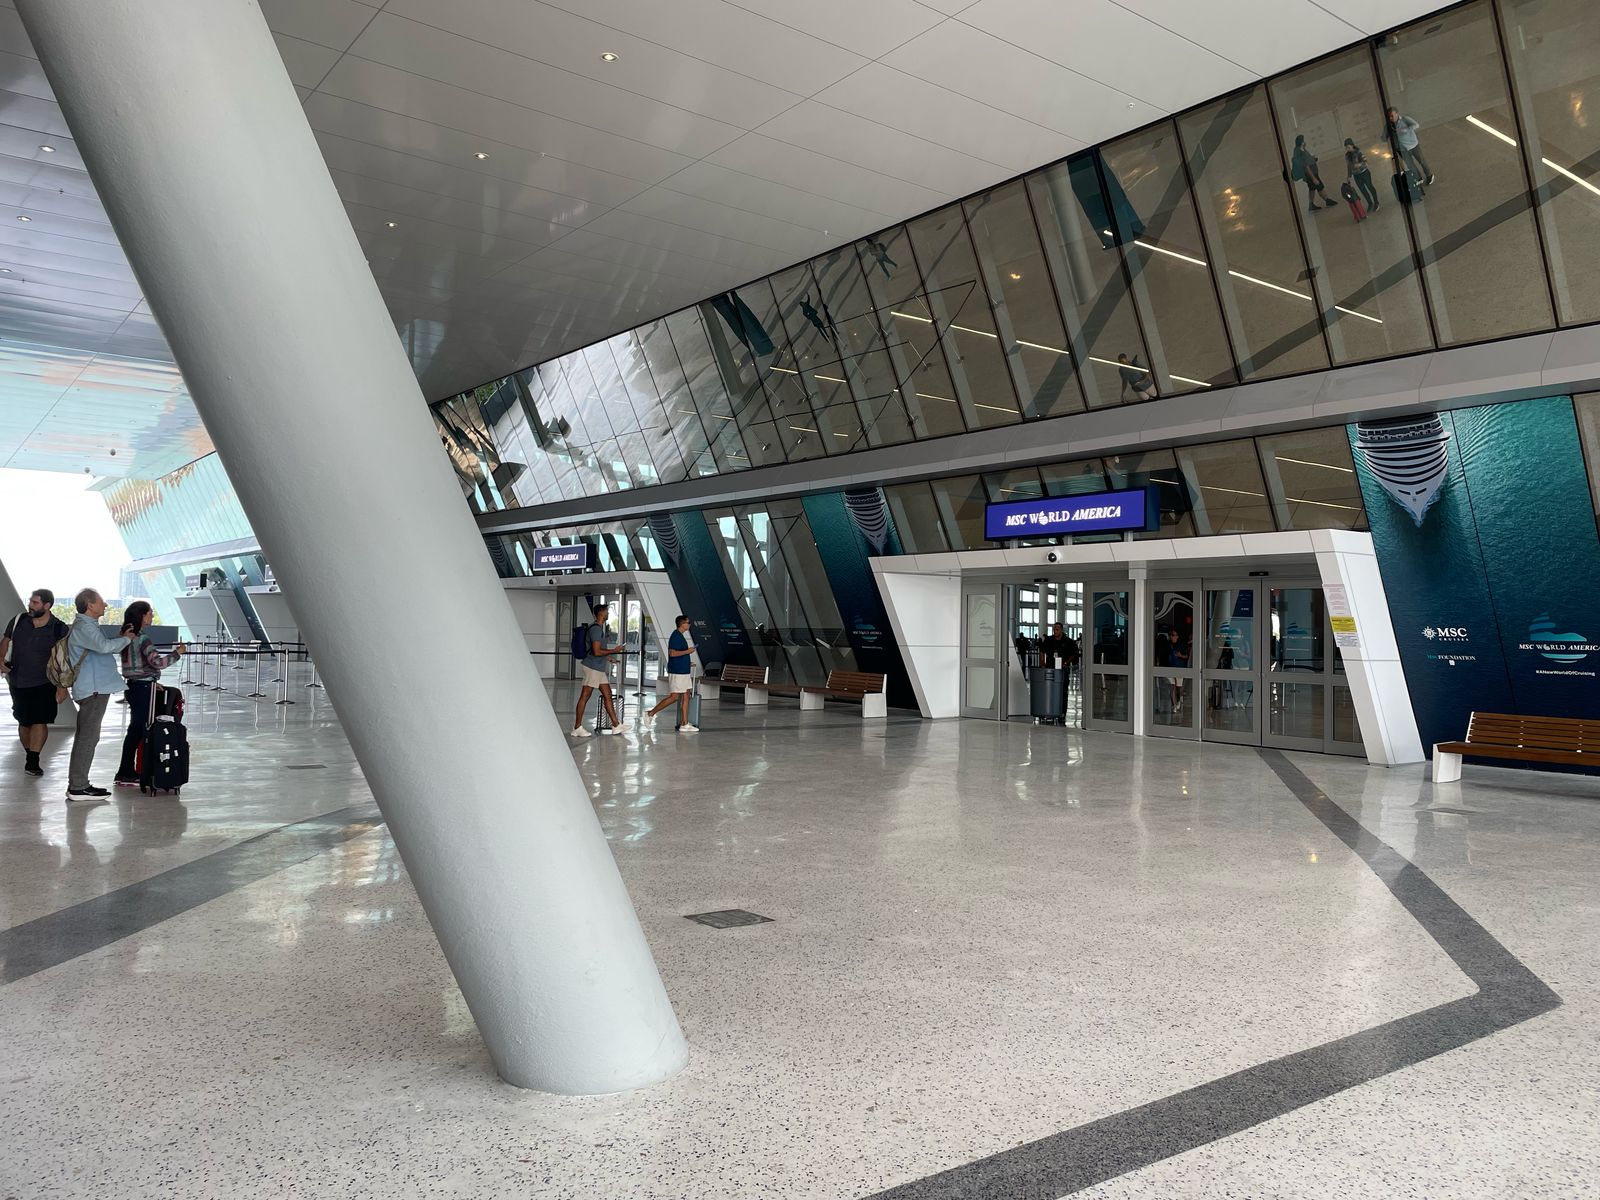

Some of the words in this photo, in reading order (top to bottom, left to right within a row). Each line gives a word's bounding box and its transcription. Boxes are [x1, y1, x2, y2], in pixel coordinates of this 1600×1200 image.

[1006, 514, 1028, 526] MSC
[1030, 510, 1070, 526] WORLD
[1072, 506, 1121, 520] AMERICA
[1436, 628, 1468, 637] MSC
[1535, 643, 1566, 651] WORLD
